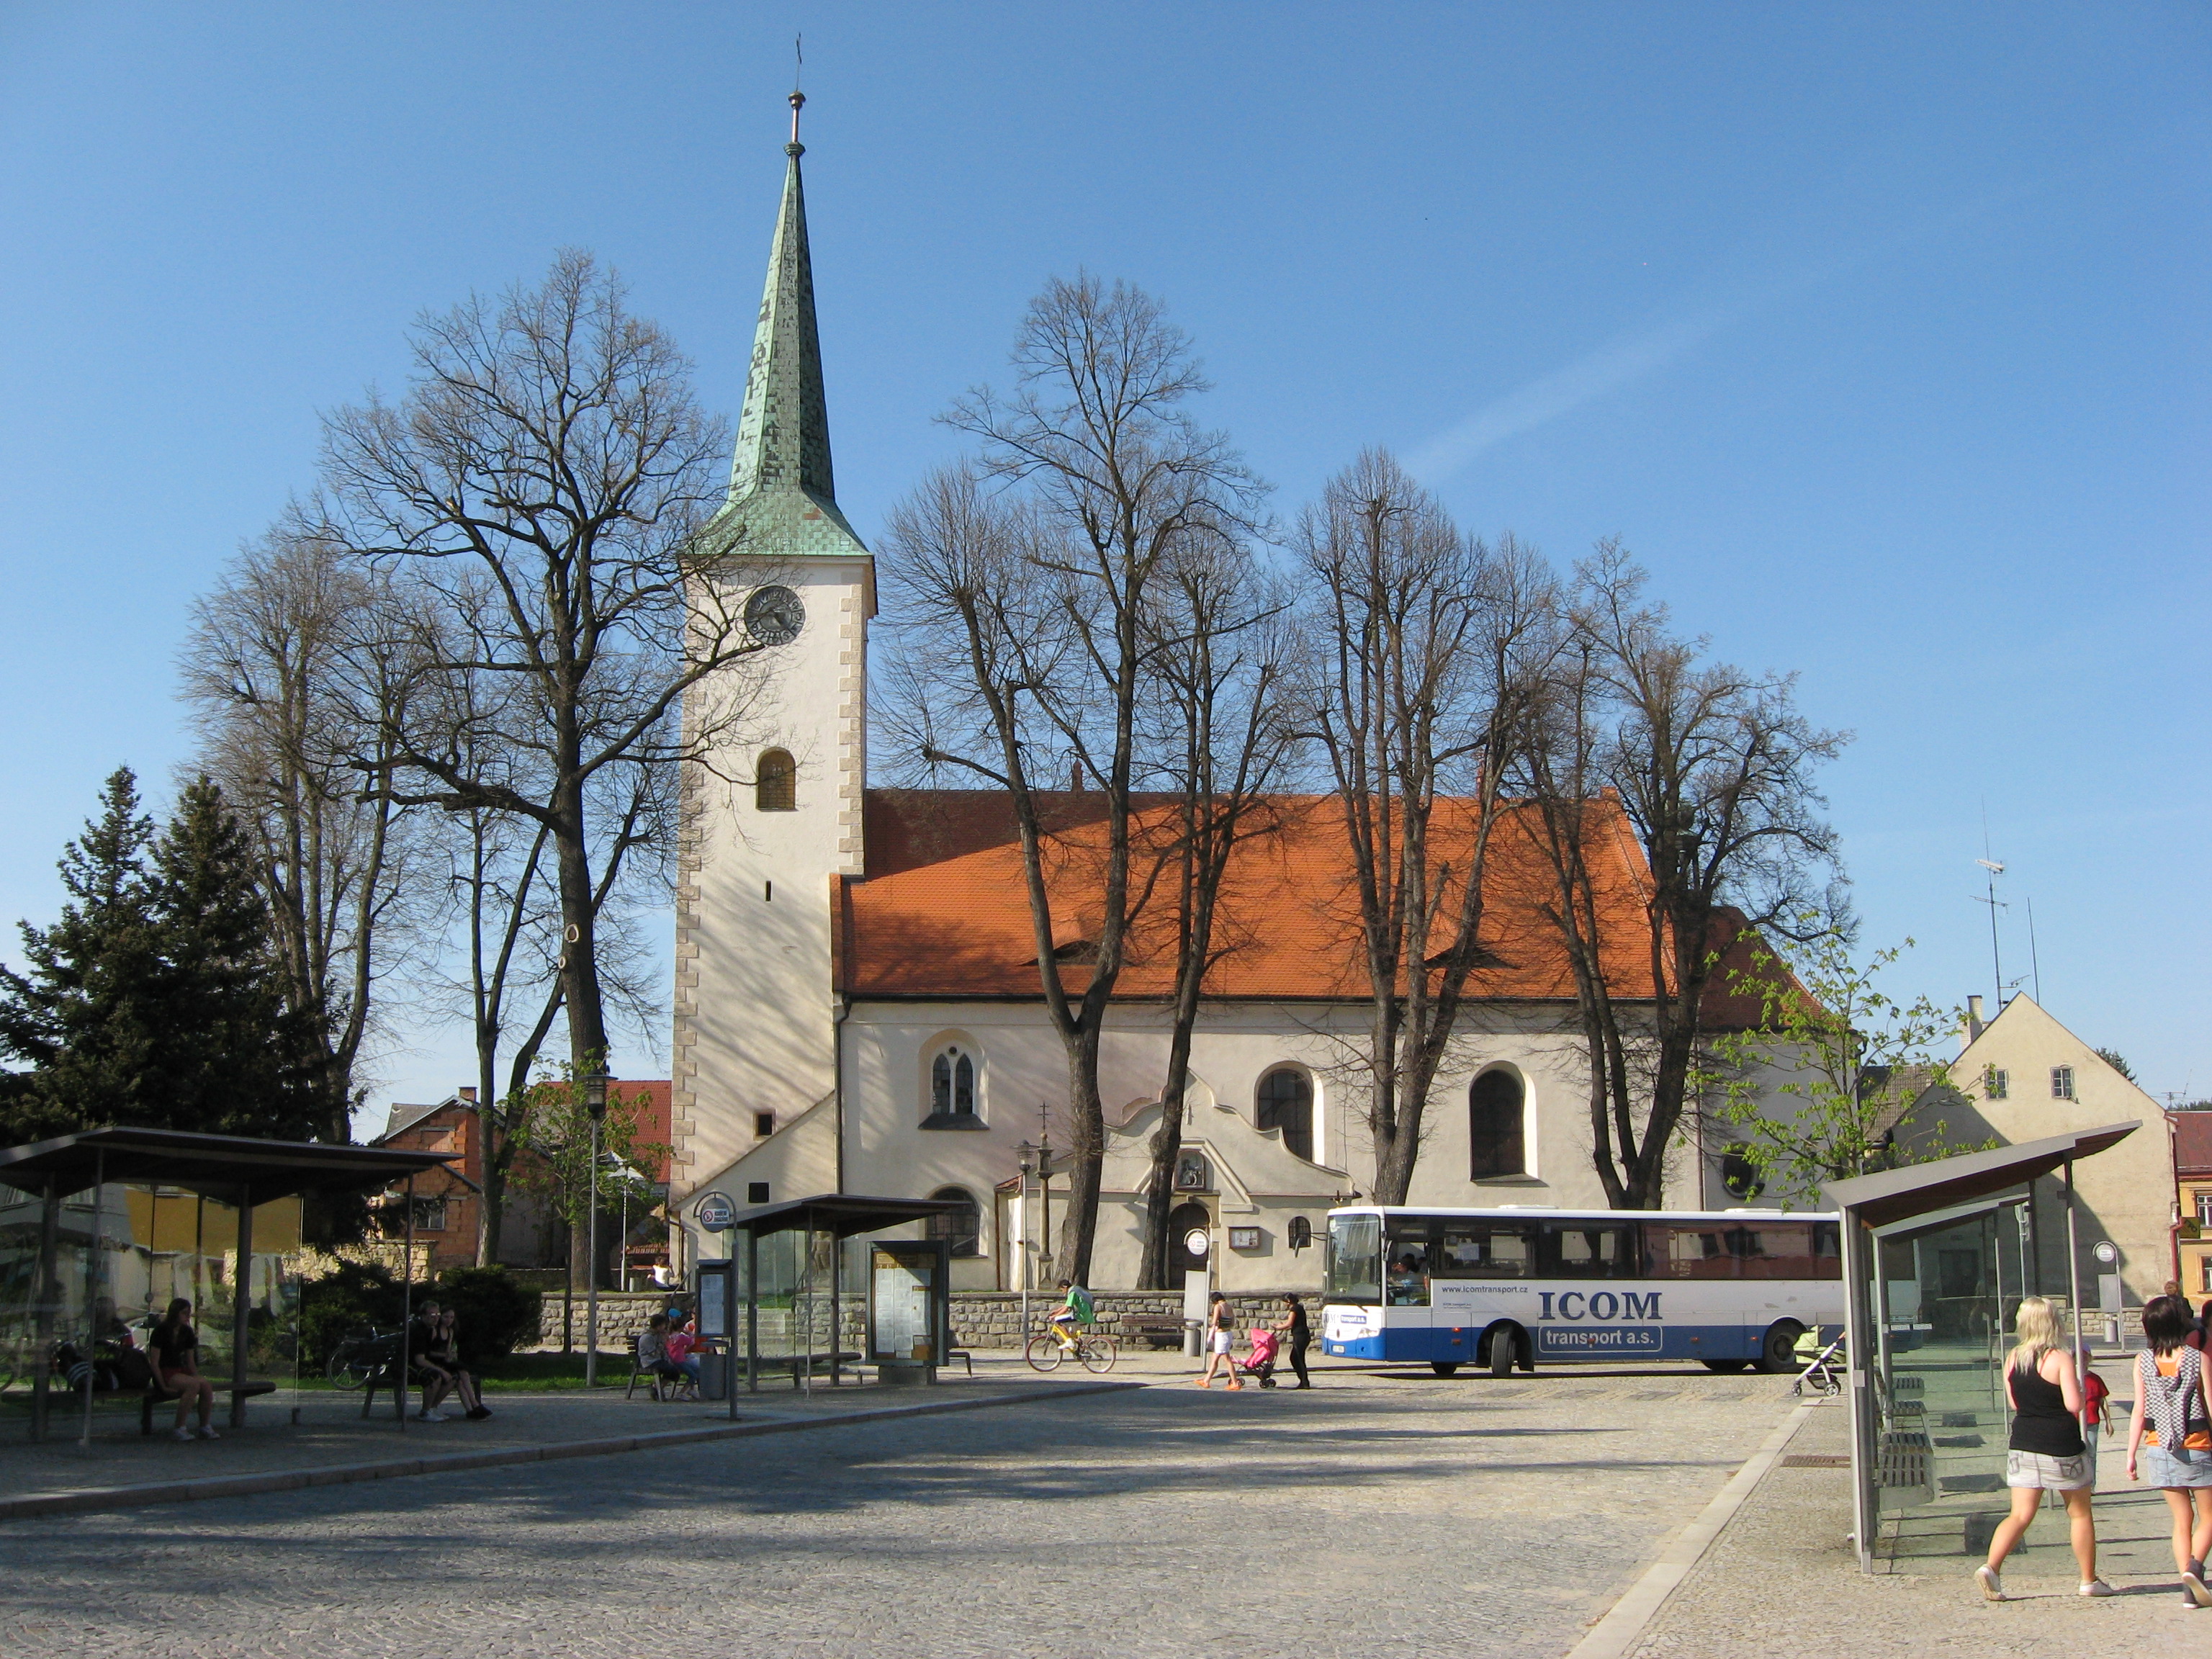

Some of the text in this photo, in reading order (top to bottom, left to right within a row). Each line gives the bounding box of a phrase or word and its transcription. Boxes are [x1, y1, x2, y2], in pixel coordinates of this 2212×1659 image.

[1441, 1285, 1529, 1294] www.icomtransport.cz
[1537, 1291, 1663, 1321] ICOM
[1546, 1330, 1655, 1349] transport a.s.
